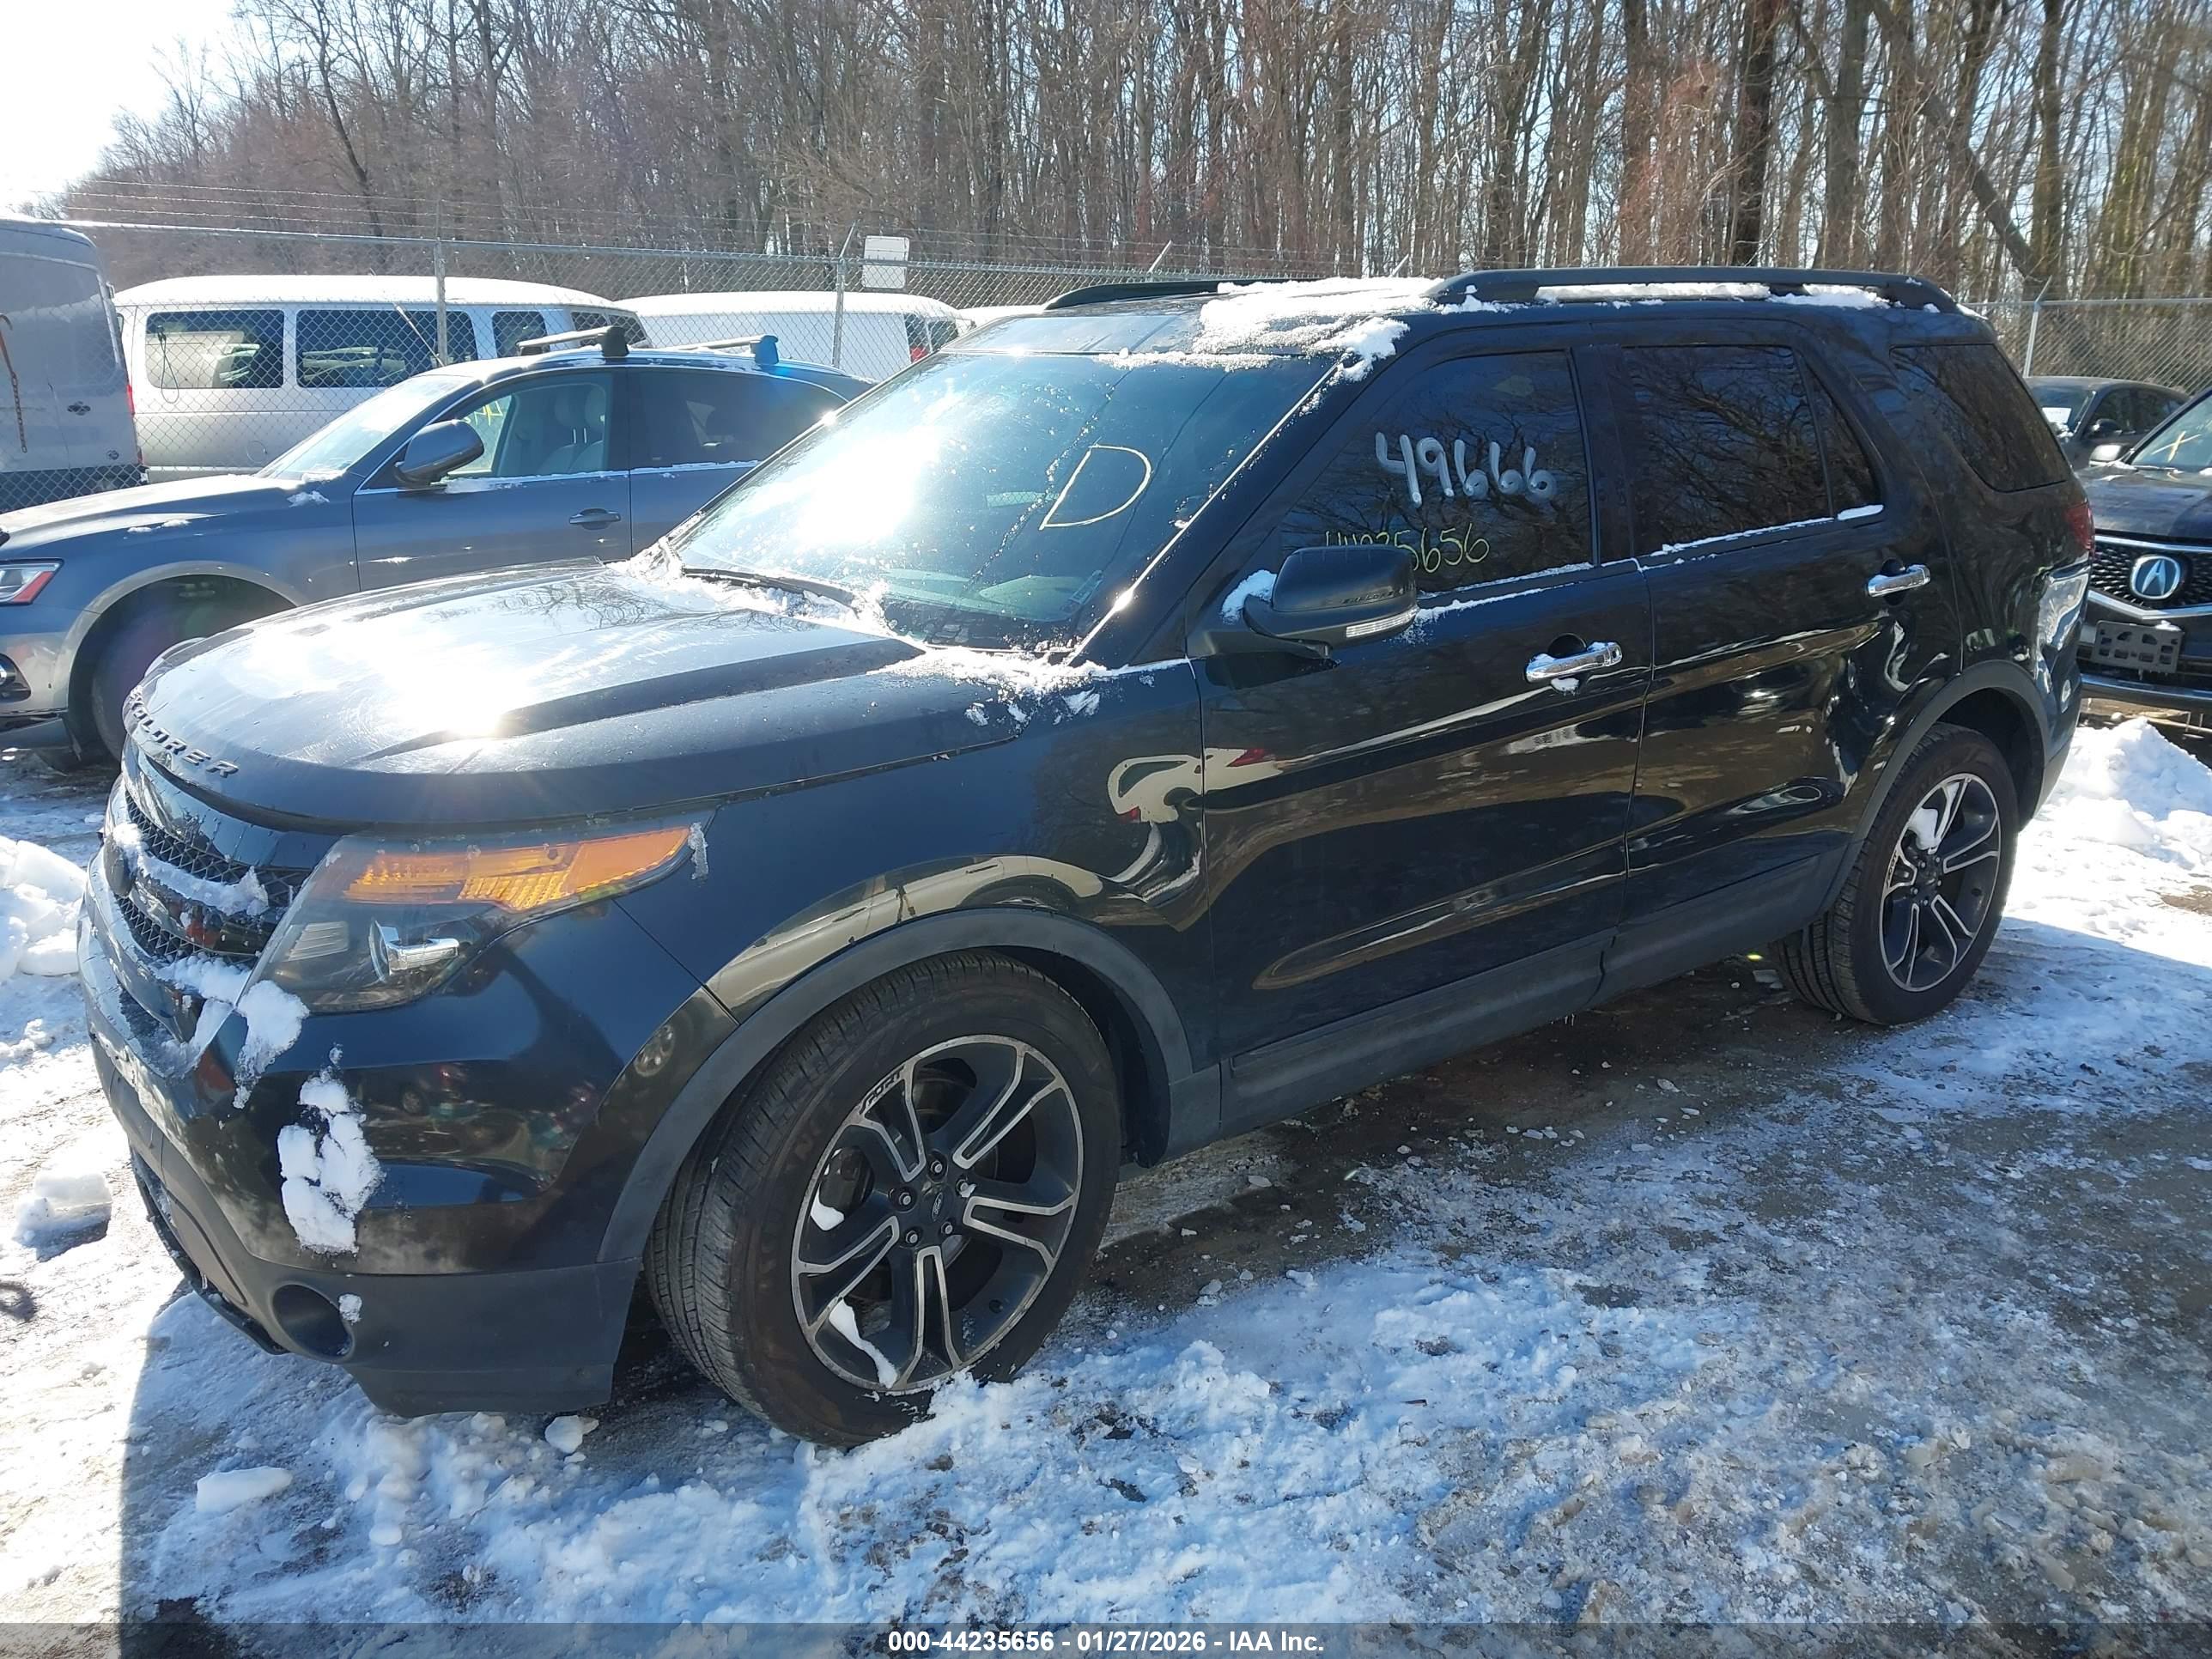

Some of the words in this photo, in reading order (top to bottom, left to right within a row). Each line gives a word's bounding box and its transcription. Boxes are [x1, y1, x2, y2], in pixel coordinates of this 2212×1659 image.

[1038, 440, 1152, 532] D
[1375, 431, 1558, 509] 49666
[1326, 523, 1490, 573] 5656
